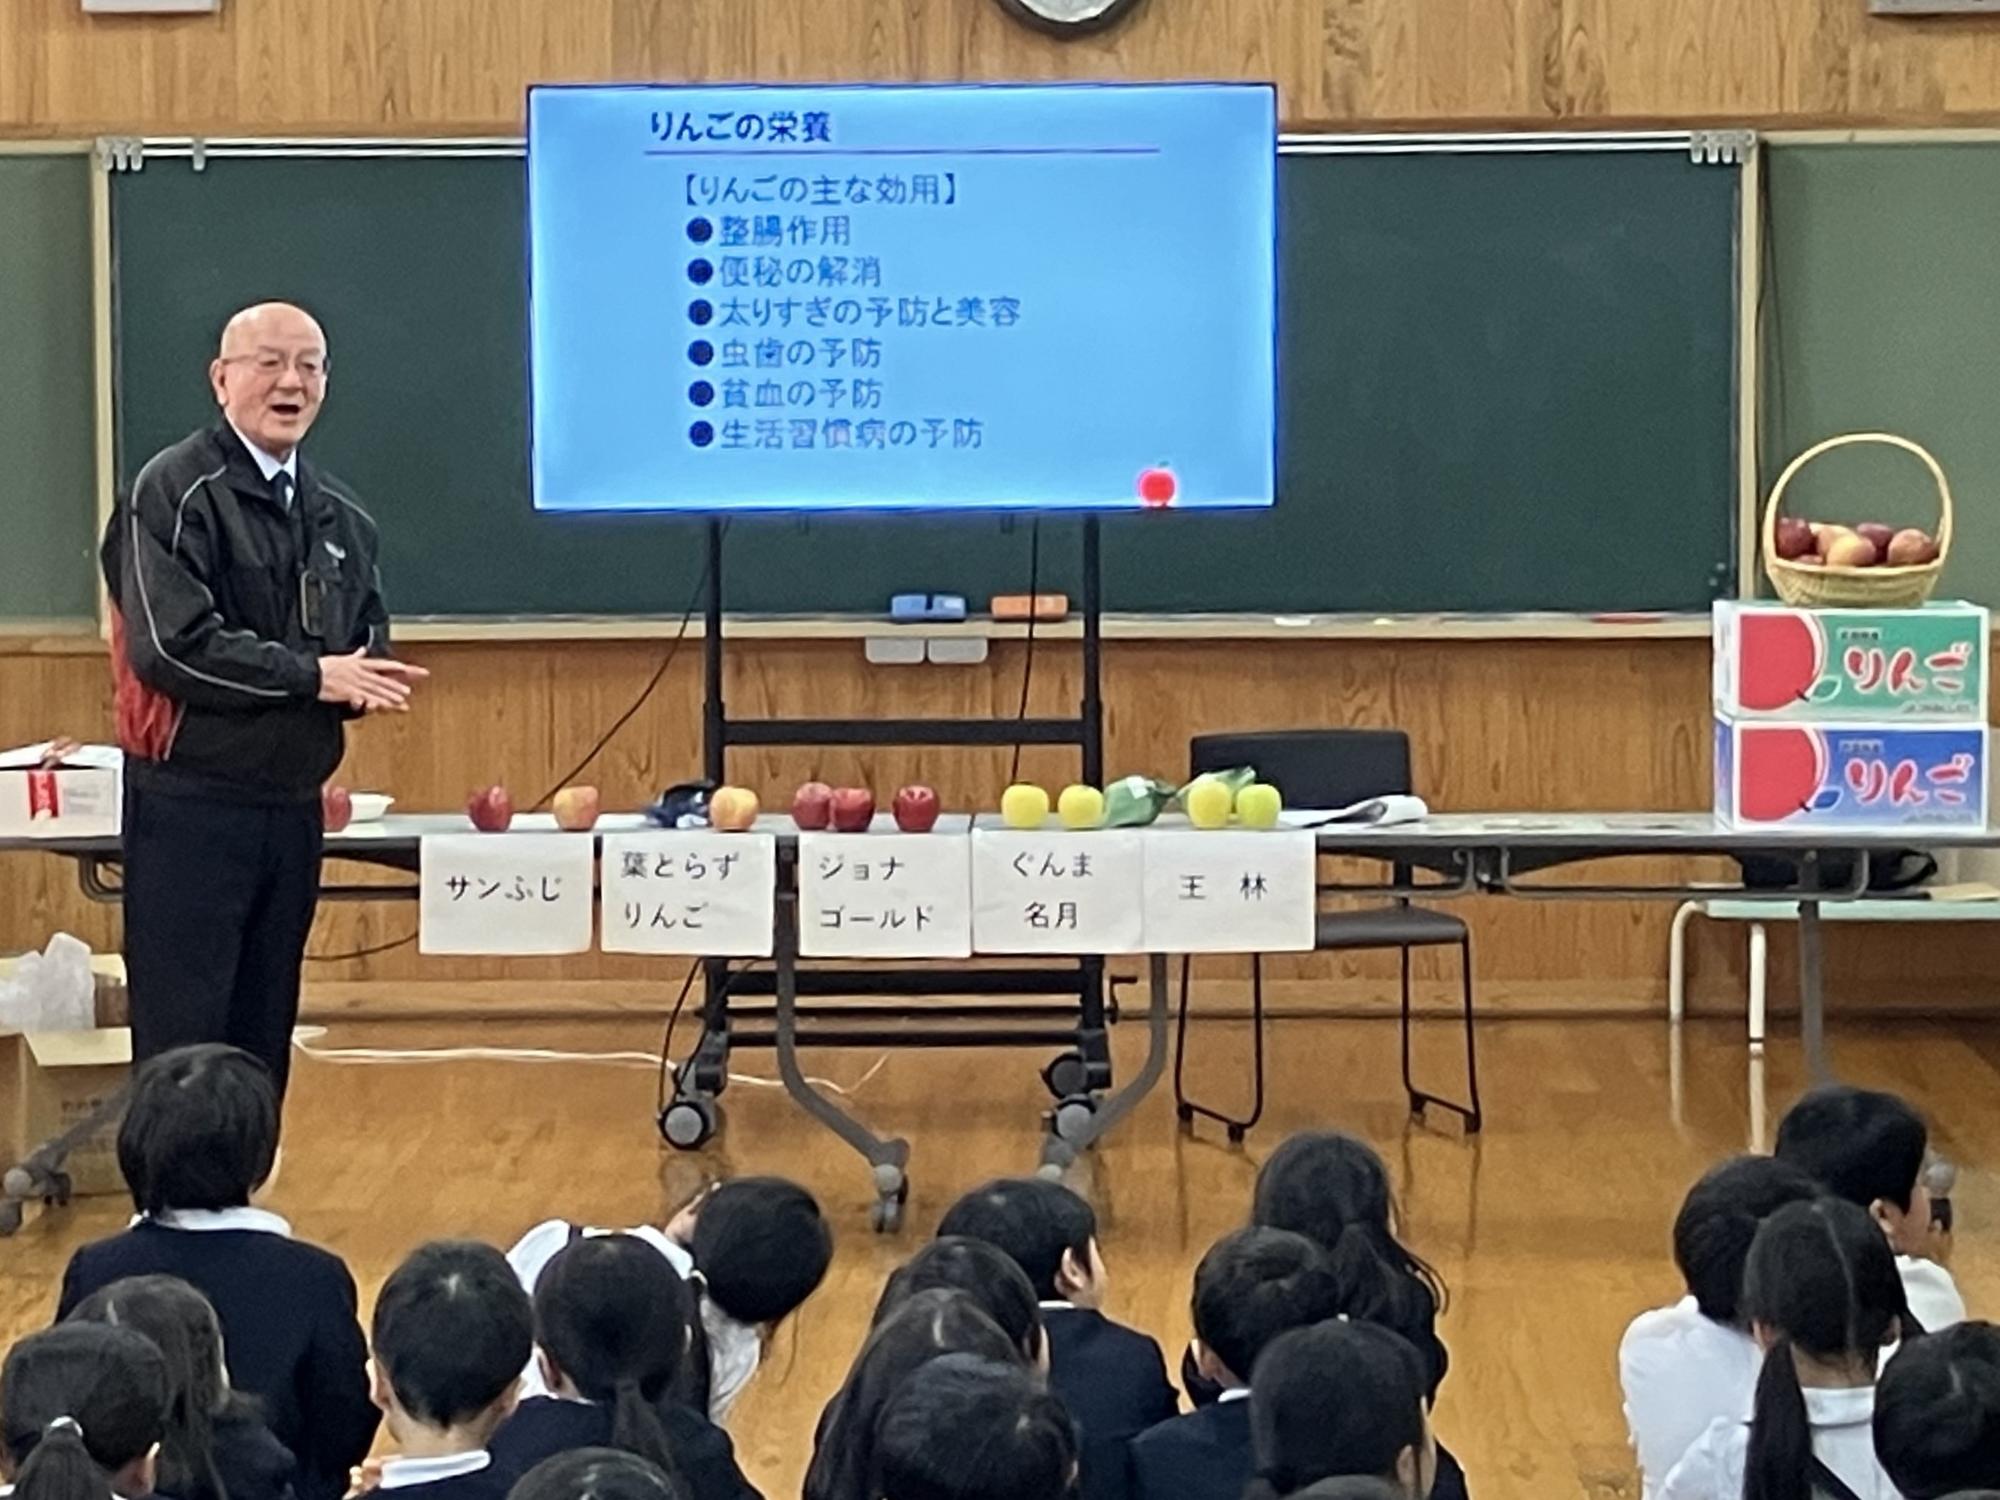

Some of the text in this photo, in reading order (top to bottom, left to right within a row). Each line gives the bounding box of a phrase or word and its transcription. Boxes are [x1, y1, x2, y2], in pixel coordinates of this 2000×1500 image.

[651, 111, 831, 142] りんごの栄養
[686, 173, 955, 205] 【りんごの主な効用】
[720, 256, 881, 287] 便秘の解消
[719, 296, 1021, 327] 太りすぎの予防と美容
[721, 337, 882, 369] 虫歯の予防
[721, 378, 882, 409] 貧血の予防
[721, 418, 984, 449] 生活習慣病の予防
[1844, 641, 1973, 694] りんご
[1845, 753, 1974, 805] りんご
[621, 851, 740, 880] 葉とらず
[819, 856, 905, 881] ジョナ
[1012, 852, 1093, 878] ぐんま
[446, 876, 562, 901] サンふじ
[625, 902, 708, 929] りんご
[820, 904, 933, 930] ゴールド
[1024, 902, 1078, 929] 名月
